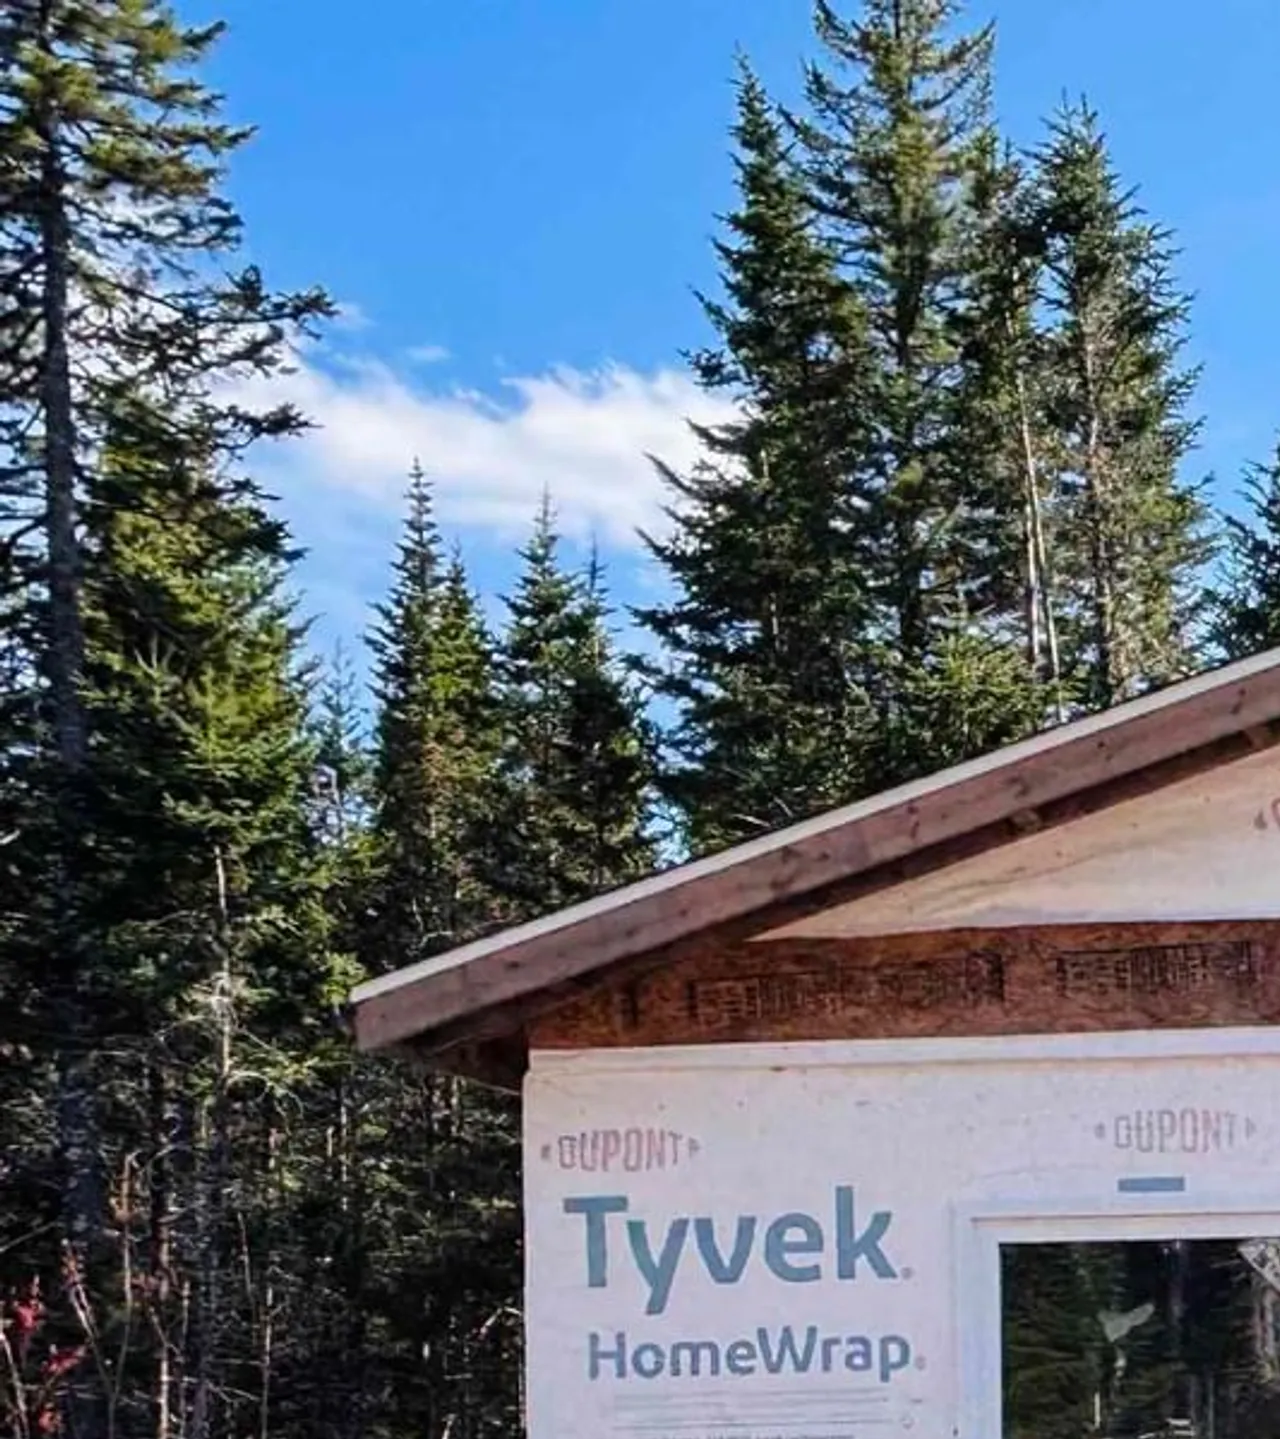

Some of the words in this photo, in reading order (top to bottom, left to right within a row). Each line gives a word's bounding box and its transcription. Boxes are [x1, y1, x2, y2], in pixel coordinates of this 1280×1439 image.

[558, 1128, 683, 1174] DUPONT
[1113, 1108, 1237, 1154] DUPONT
[562, 1185, 899, 1316] Tyvek
[588, 1324, 913, 1383] HomeWrap
